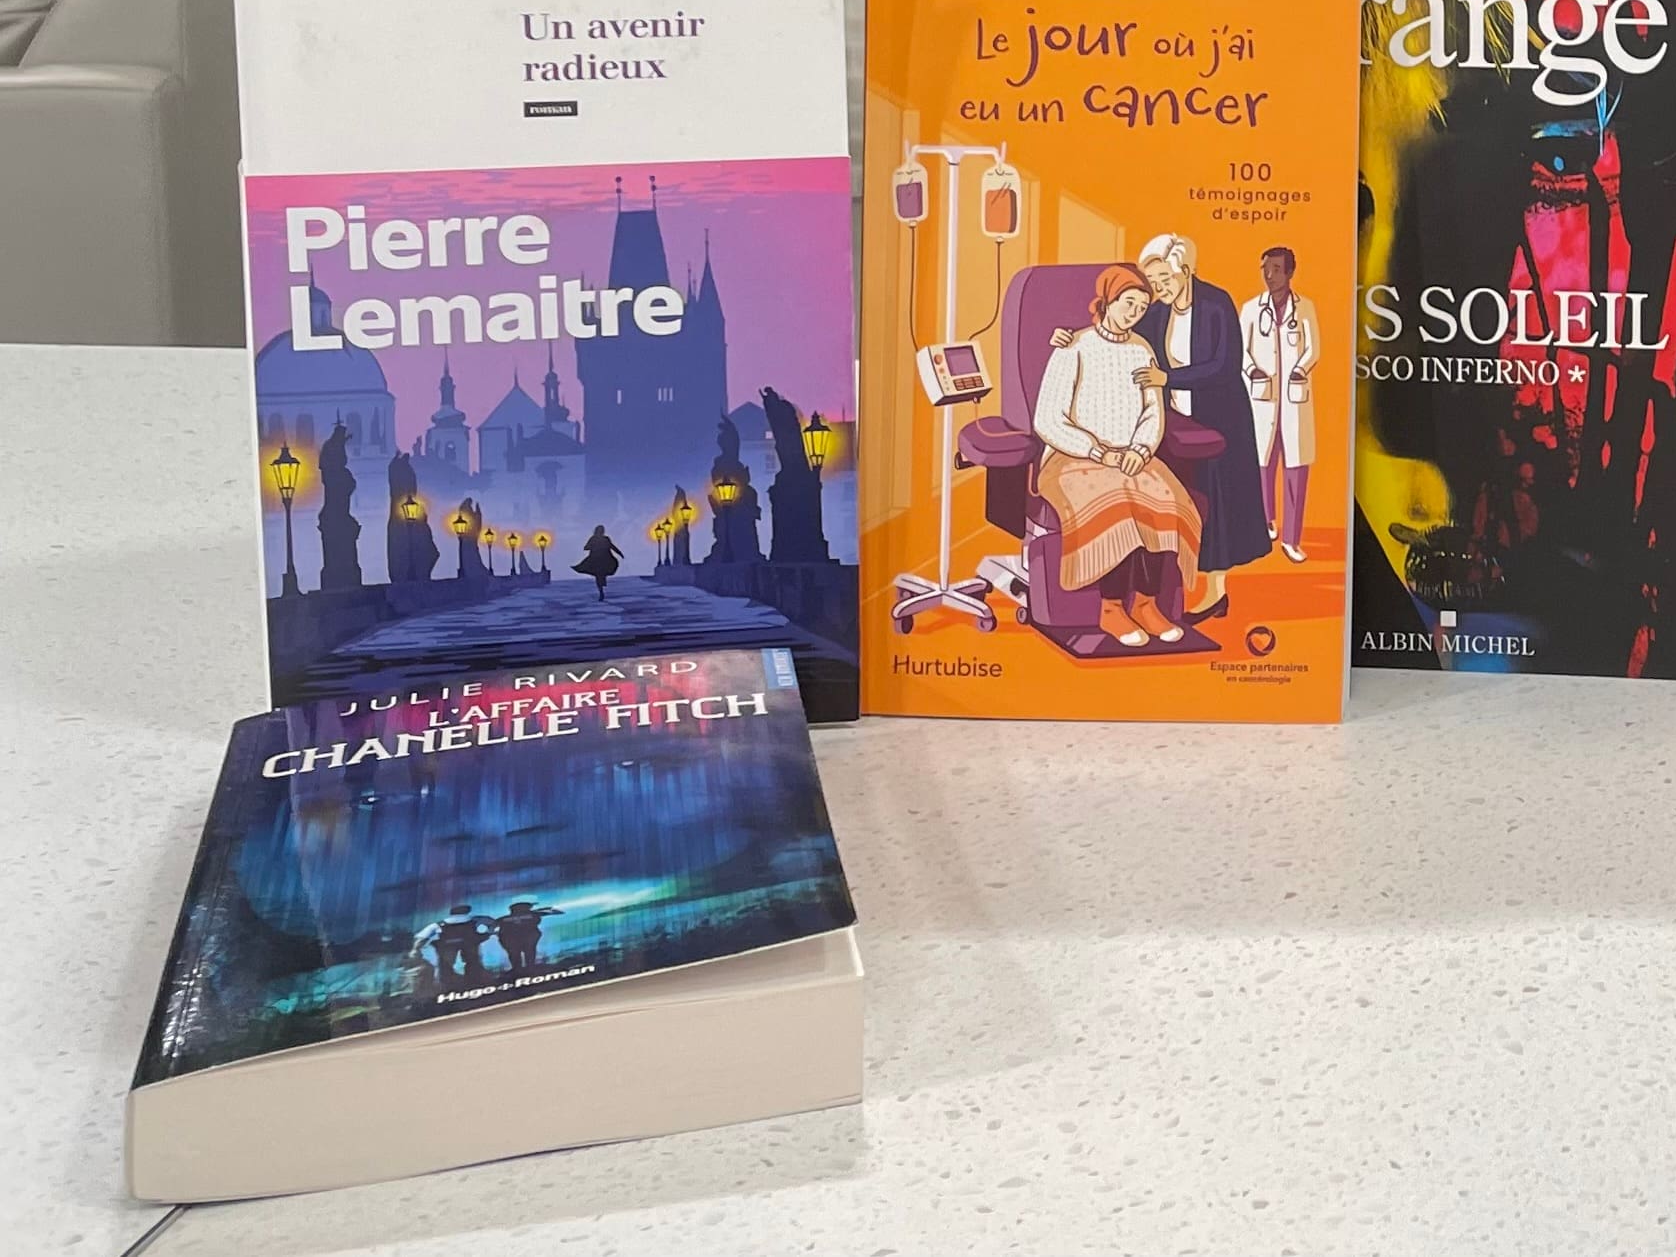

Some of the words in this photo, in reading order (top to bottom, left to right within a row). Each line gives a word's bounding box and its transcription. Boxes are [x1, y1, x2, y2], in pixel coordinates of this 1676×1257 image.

[521, 13, 575, 41] Un
[588, 11, 704, 40] avenir
[977, 18, 1009, 60] Le
[1006, 8, 1138, 87] jour
[1154, 32, 1194, 57] où
[1199, 25, 1254, 78] j'ai
[523, 54, 667, 82] radieux
[960, 103, 1000, 121] eu
[1018, 100, 1064, 123] un
[1083, 84, 1267, 127] cancer
[1229, 163, 1272, 181] 100
[1189, 187, 1311, 204] témoignages
[1212, 207, 1287, 224] d'espoir
[286, 206, 550, 273] Pierre
[290, 276, 684, 351] Lemaitre
[1358, 284, 1402, 342] S
[1418, 286, 1669, 350] SOLEIL
[1420, 358, 1559, 386] INFERNO
[1361, 632, 1433, 651] ALBIN
[1441, 634, 1535, 656] MICHEL
[893, 654, 1003, 678] Hurtubise
[1210, 661, 1247, 673] Espace
[1250, 662, 1308, 673] partenaires
[340, 682, 482, 716] JULIE
[515, 661, 698, 689] RIVARD
[429, 688, 620, 727] L'AFFAIRE
[262, 712, 579, 778] CHANELLE
[606, 693, 768, 731] FITCH
[437, 986, 495, 1003] Hugo
[515, 964, 595, 987] Roman
